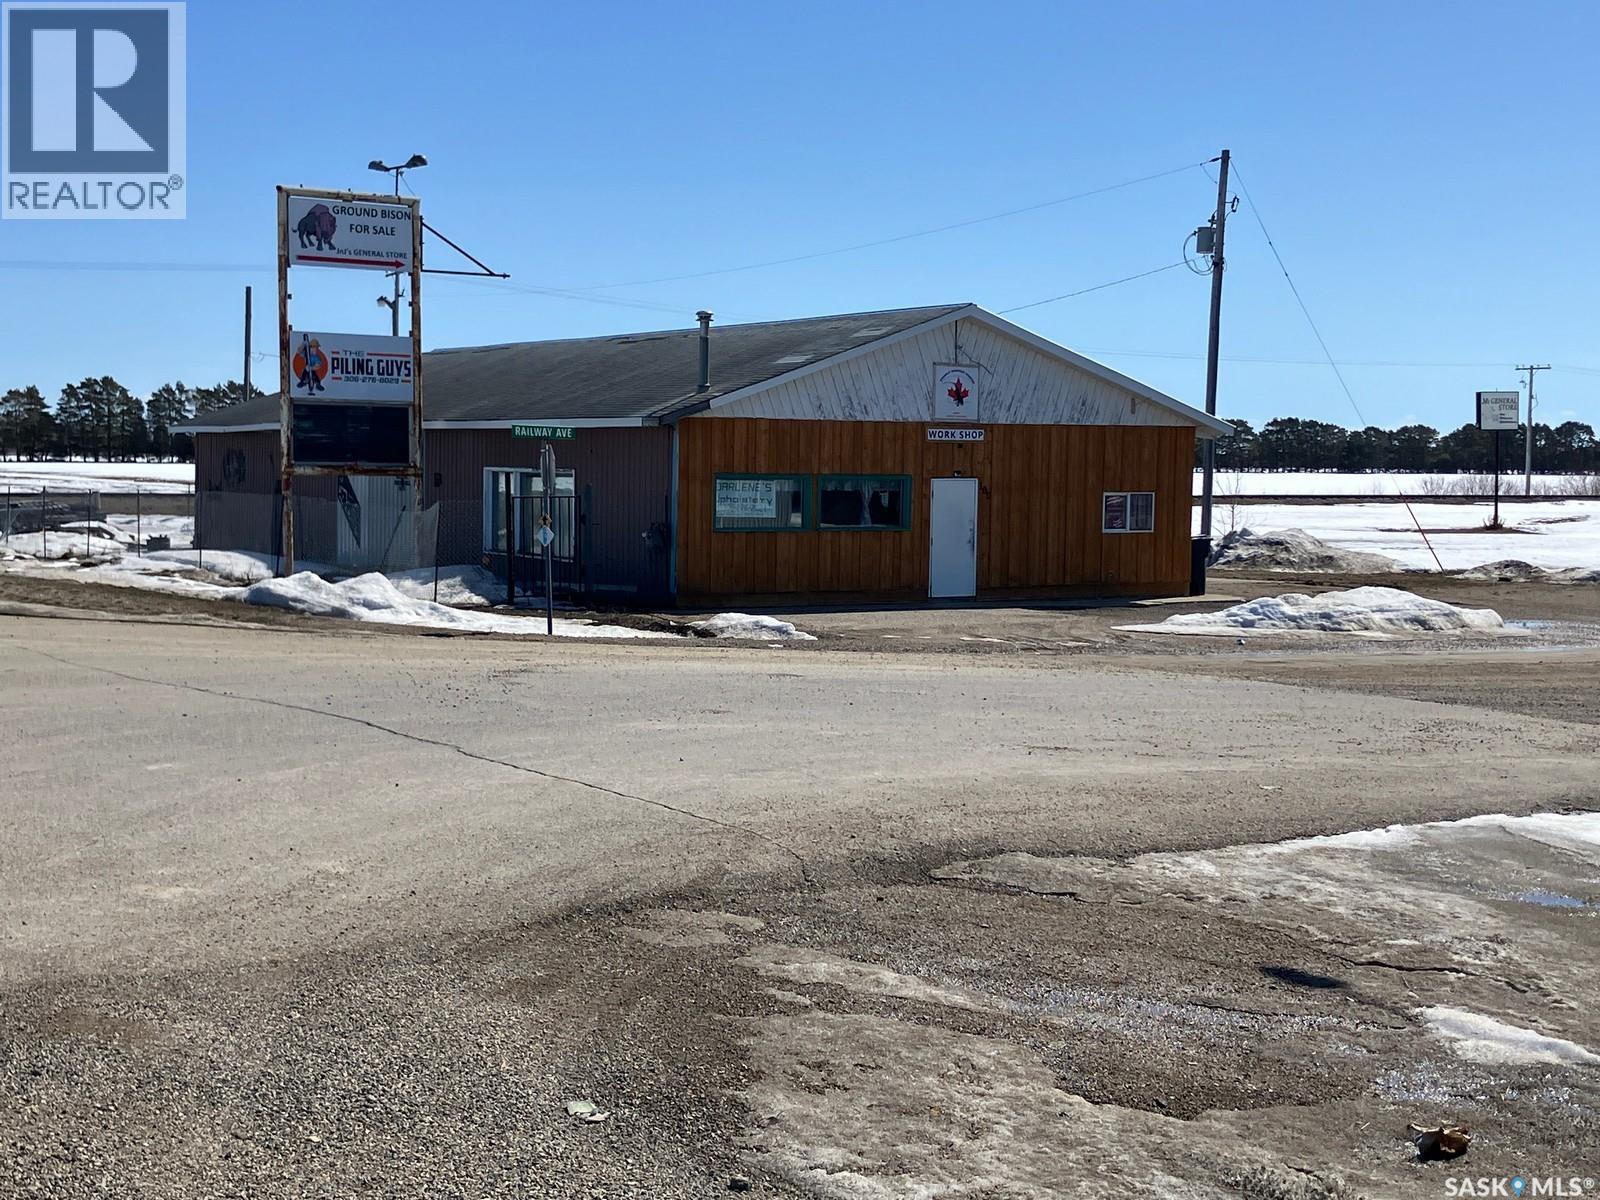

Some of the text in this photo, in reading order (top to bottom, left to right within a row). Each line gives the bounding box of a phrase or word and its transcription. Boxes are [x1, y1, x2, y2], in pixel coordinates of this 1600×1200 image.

[332, 205, 411, 220] GROUND BISON
[349, 223, 396, 236] FOR SALE
[353, 249, 385, 258] GENERAL
[386, 251, 408, 259] STORE
[331, 357, 411, 377] PILING GUYS
[515, 426, 572, 438] RAILWAY AVE
[928, 430, 984, 439] WORK SHOP
